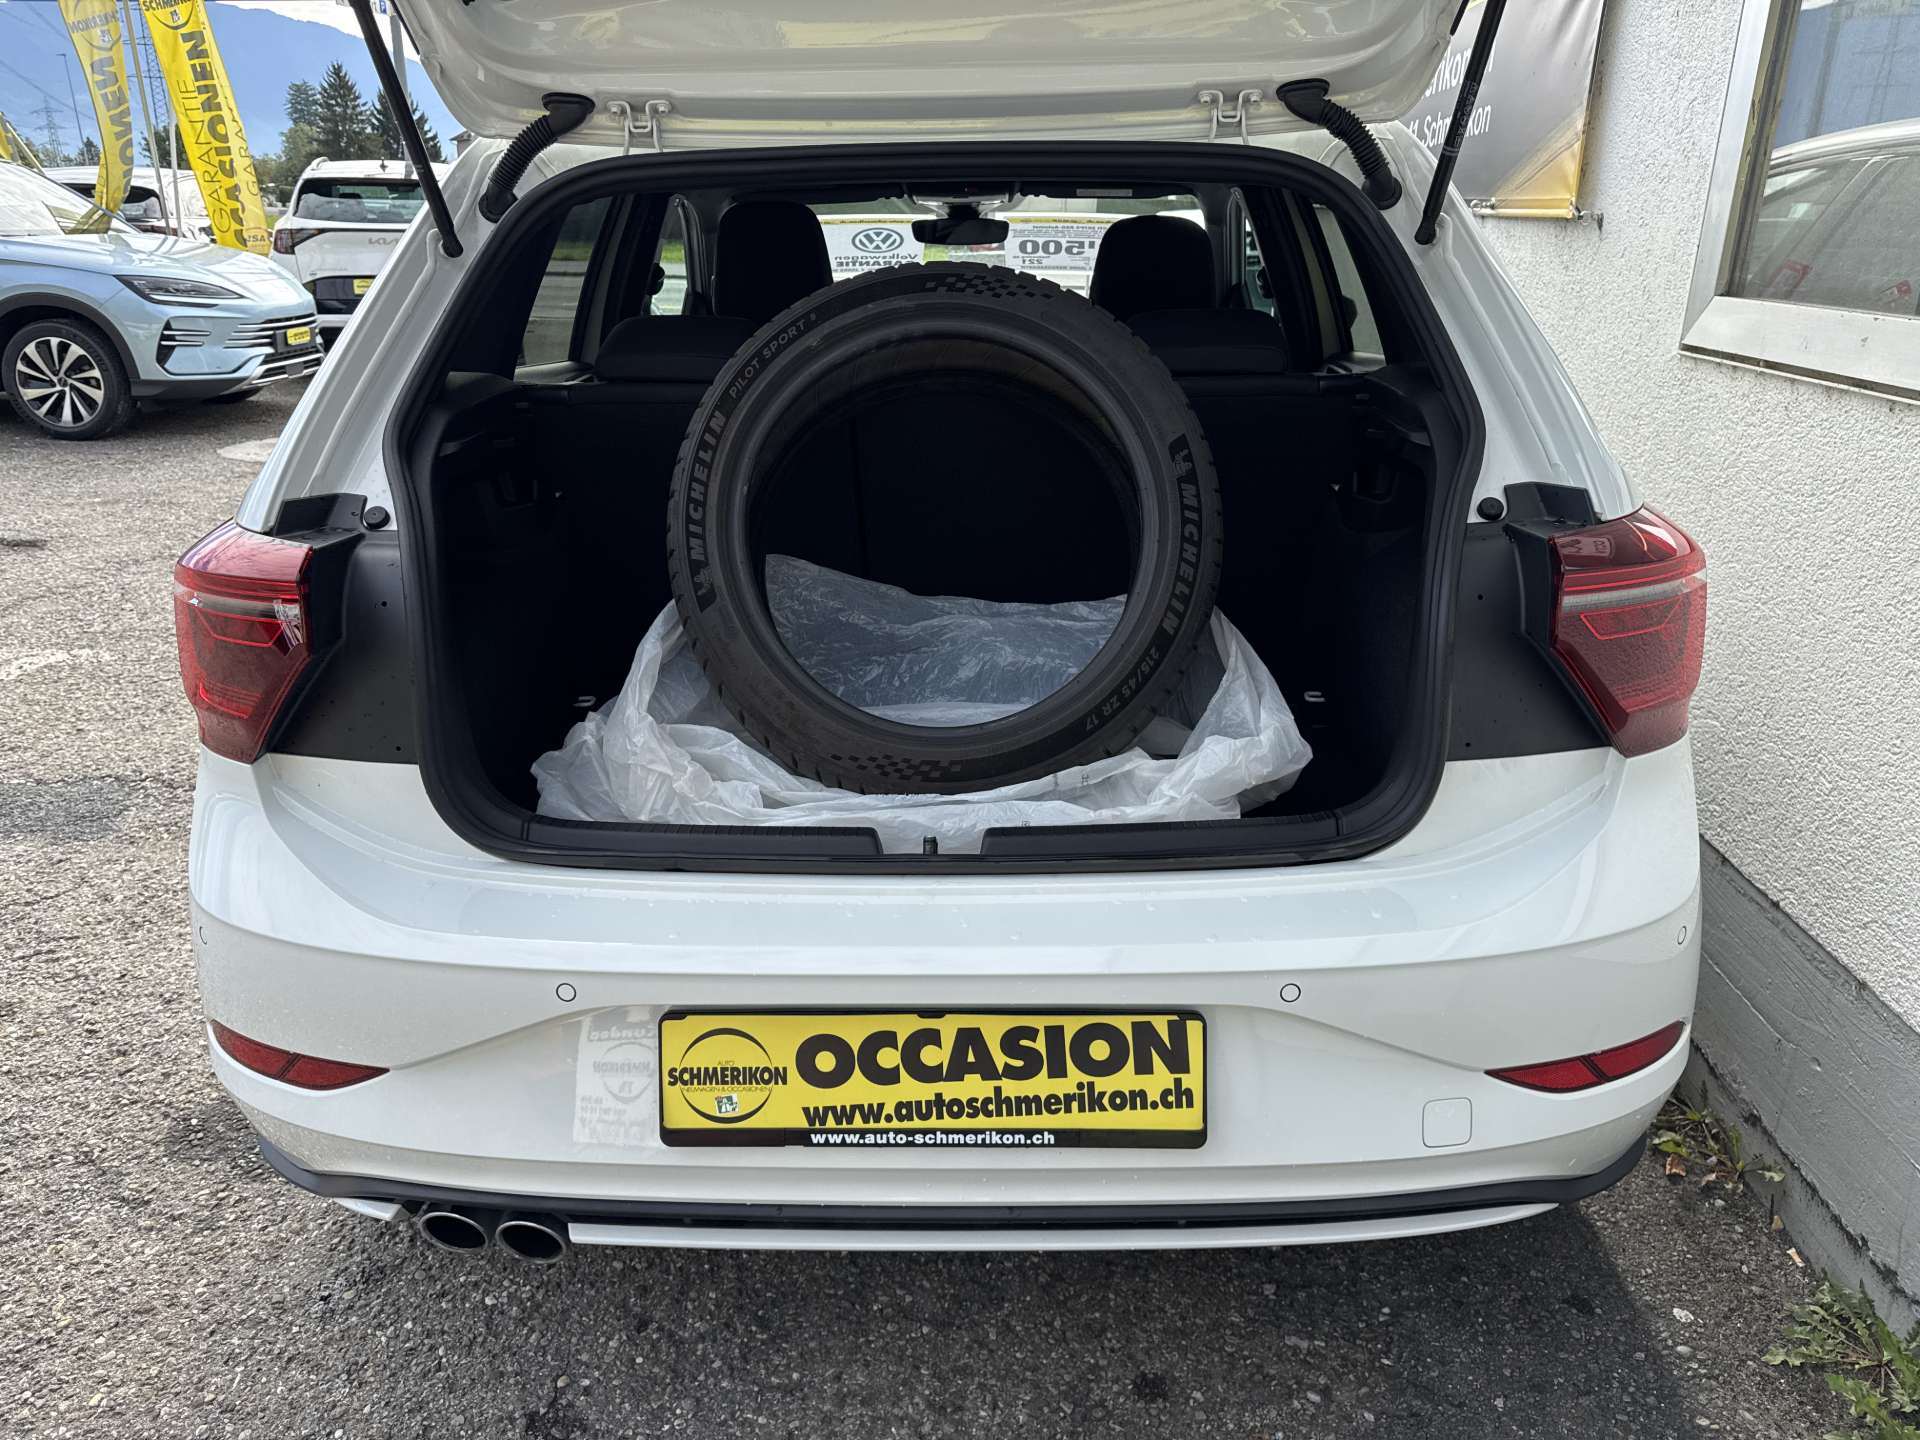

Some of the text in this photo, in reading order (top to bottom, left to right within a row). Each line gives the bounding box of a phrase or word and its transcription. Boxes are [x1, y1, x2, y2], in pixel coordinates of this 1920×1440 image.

[177, 79, 232, 234] GARANTIE
[1422, 105, 1492, 148] Schmkon
[688, 319, 806, 561] MICHELIN PILOT SPORT
[1161, 481, 1199, 637] MICHELIN
[668, 1066, 787, 1087] SCHMERIKON
[795, 1019, 1191, 1090] OCCASION
[801, 1077, 1194, 1127] www.autoschmerikon.ch
[810, 1130, 1055, 1145] www.auto-schmerikon.ch
